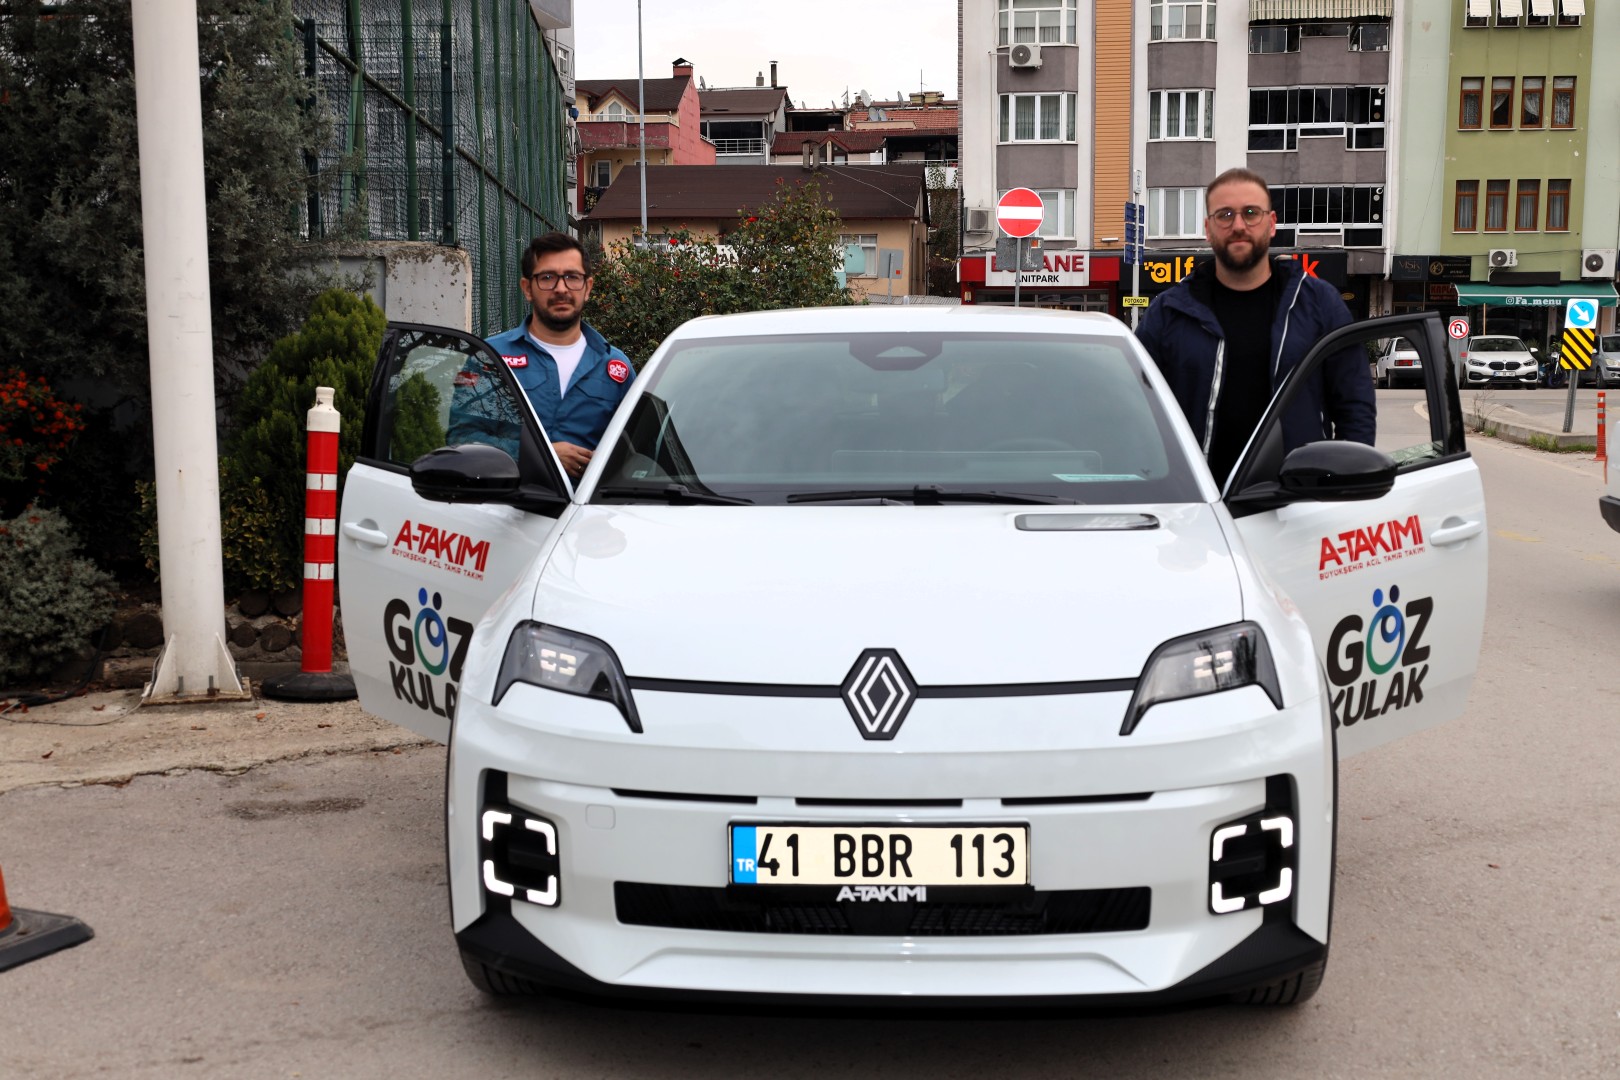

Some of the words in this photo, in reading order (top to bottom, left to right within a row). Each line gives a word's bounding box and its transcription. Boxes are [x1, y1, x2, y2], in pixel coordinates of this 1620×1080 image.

[393, 519, 491, 573] A-TAKIMI
[1318, 514, 1424, 571] A-TAKIMI
[383, 587, 474, 683] GÖZ
[1326, 584, 1434, 687] GÖZ
[388, 660, 458, 721] KULA
[736, 858, 755, 873] TR
[757, 832, 799, 877] 41
[833, 833, 913, 878] BBR
[950, 832, 1015, 878] 113
[836, 885, 927, 902] A-TAKIMI
